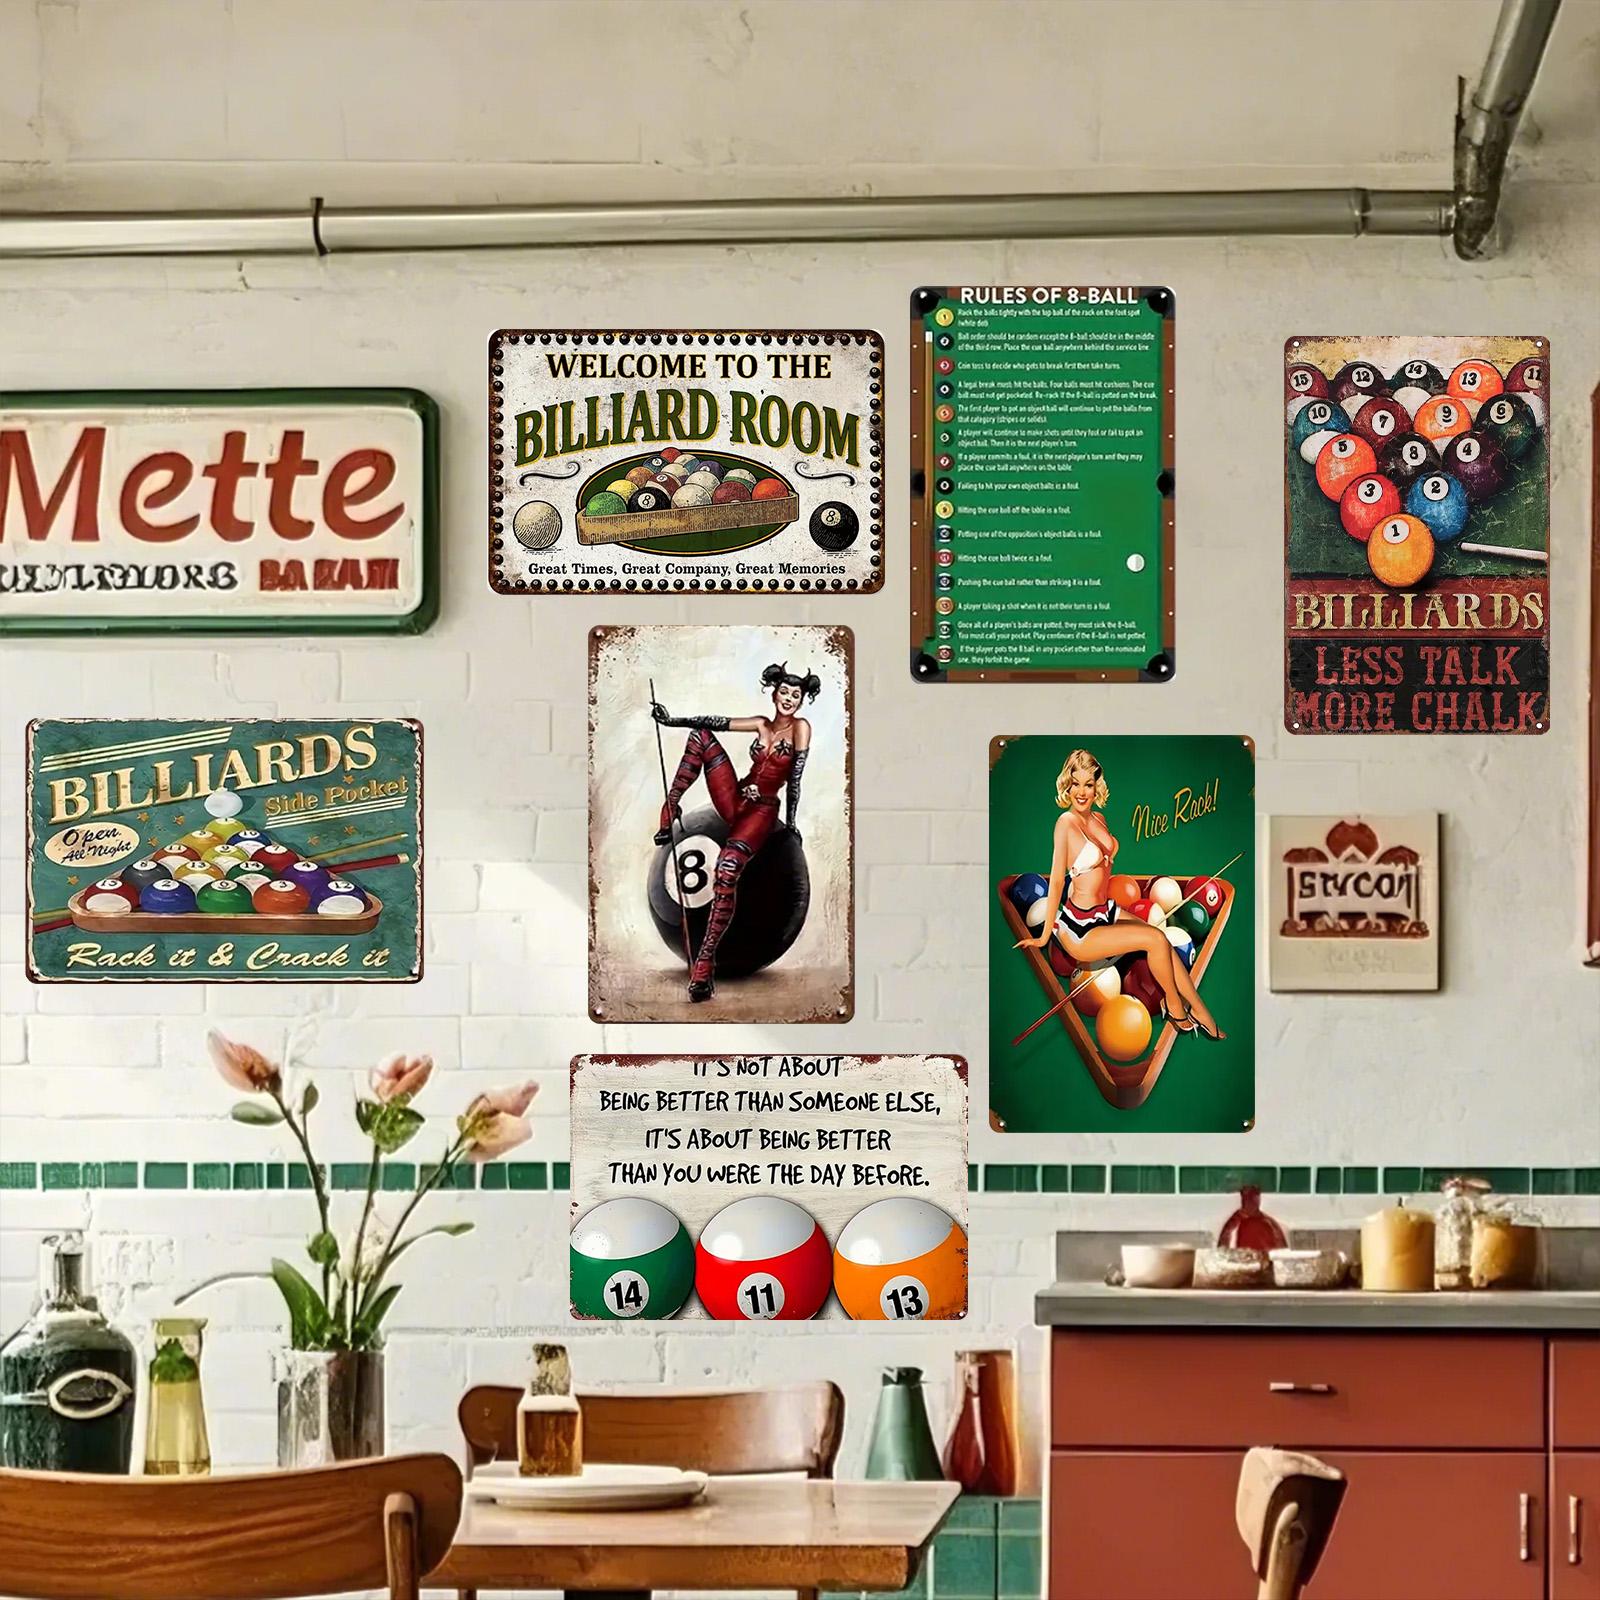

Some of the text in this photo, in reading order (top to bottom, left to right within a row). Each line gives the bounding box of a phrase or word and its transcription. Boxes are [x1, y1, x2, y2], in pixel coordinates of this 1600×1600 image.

[961, 287, 1138, 304] RULES OF 8-BALL
[546, 354, 831, 378] WELCOME TO THE
[1408, 364, 1422, 375] 14
[1294, 374, 1308, 385] 15
[1356, 371, 1370, 382] 12
[1461, 372, 1477, 385] 13
[1311, 407, 1327, 419] 10
[1443, 406, 1451, 418] 9
[1497, 404, 1506, 416] 6
[514, 388, 860, 468] BILLIARD ROOM
[1379, 415, 1389, 428] 7
[1338, 440, 1347, 452] 5
[1409, 446, 1418, 459] 8
[1462, 443, 1472, 456] 4
[0, 427, 405, 542] Mette
[1365, 484, 1375, 497] 3
[1431, 481, 1441, 494] 2
[642, 495, 651, 506] 8
[826, 510, 835, 522] 8
[1392, 524, 1399, 536] 1
[528, 563, 846, 577] Great Times, Great Company, Great Memories
[1291, 592, 1544, 630] BILLIARDS
[1315, 646, 1520, 685] LESS TALK
[1294, 692, 1543, 731] MORE CHALK
[48, 726, 377, 824] BILLIARDS
[265, 775, 409, 816] Side Pocket
[1132, 778, 1219, 842] Nice Rack!
[90, 841, 131, 859] Night
[678, 850, 709, 895] 8
[335, 881, 352, 889] 12
[66, 943, 390, 970] Rack it & Crack it
[737, 1057, 772, 1077] NOT
[779, 1056, 844, 1077] ABOUT
[600, 1091, 940, 1115] BEING BETTER THAN SOMEONE ELSE,
[646, 1128, 891, 1150] IT'S ABOUT BEING BETTER
[608, 1162, 930, 1187] THAN YOU WERE THE DAY BEFORE.
[609, 1281, 642, 1310] 14
[744, 1283, 775, 1315] 11
[886, 1285, 924, 1318] 13
